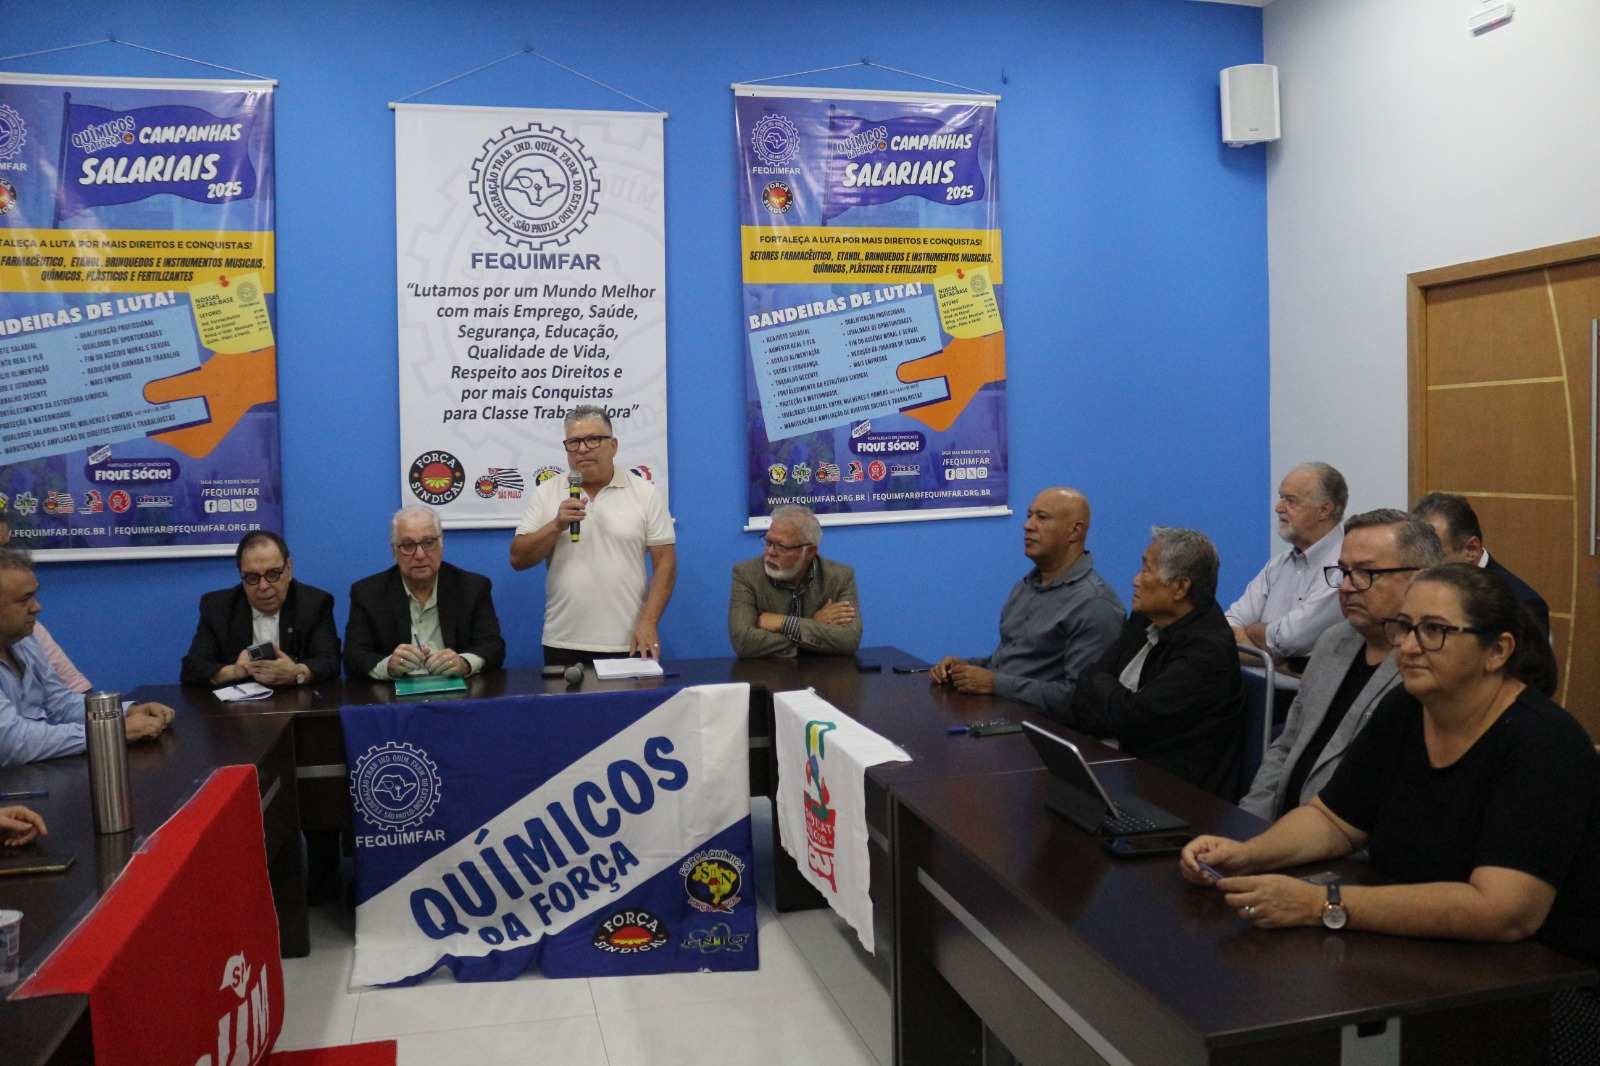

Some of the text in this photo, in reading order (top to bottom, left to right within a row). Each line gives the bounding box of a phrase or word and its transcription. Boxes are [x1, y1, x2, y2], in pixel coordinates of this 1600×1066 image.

[72, 115, 136, 148] QUÍMICOS
[138, 123, 243, 145] CAMPANHAS
[837, 125, 889, 153] QUÍMICOS
[84, 135, 121, 154] DA FORÇA
[513, 141, 533, 154] IND.
[890, 133, 973, 152] CAMPANHAS
[492, 148, 515, 171] TRAB.
[79, 153, 221, 185] SALARIAIS
[752, 166, 801, 175] FEQUIMFAR
[842, 160, 956, 188] SALARIAIS
[207, 181, 242, 199] 2025
[573, 179, 582, 192] DO
[766, 182, 789, 194] FORÇA
[946, 185, 974, 201] 2025
[487, 171, 513, 224] FEDERAÇÃO
[763, 199, 793, 214] SINDICAL
[558, 194, 582, 224] ESTADO
[40, 240, 47, 248] A
[50, 240, 76, 249] LUTA
[79, 240, 99, 249] POR
[102, 240, 127, 249] MAIS
[129, 240, 175, 249] DIREITOS
[178, 241, 184, 249] E
[186, 241, 253, 251] CONQUISTAS!
[759, 235, 810, 246] FORTALEÇA
[812, 236, 819, 244] A
[820, 236, 841, 244] LUTA
[842, 236, 860, 244] POR
[862, 236, 882, 245] MAIS
[884, 237, 922, 245] DIREITOS
[929, 238, 983, 246] CONQUISTAS!
[1, 253, 266, 270] FARMACÊUTICO, ETANOL, BRINQUEDOS E INSTRUMENTOS MUSICAIS,
[471, 252, 602, 270] FEQUIMFAR
[750, 251, 779, 261] SETORES
[780, 249, 834, 262] FARMACÊUTICO,
[837, 251, 864, 262] ETANOL,
[864, 252, 905, 262] BRINQUEDOS
[911, 252, 960, 262] INSTRUMENTOS
[961, 253, 993, 263] MUSICAIS,
[41, 268, 194, 282] QUÍMICOS, PLÁSTICOS E FERTILIZANTES
[813, 262, 848, 274] QUÍMICOS,
[849, 262, 884, 274] PLÁSTICOS
[891, 264, 937, 274] FERTILIZANTES
[195, 293, 220, 305] NOSSAS
[406, 282, 656, 300] “Lutamos por um Mundo Melhor
[85, 301, 114, 320] DE
[116, 289, 176, 314] LUTA!
[196, 296, 234, 310] DATAS-BASE
[436, 303, 639, 321] com mais Emprego, Saúde,
[749, 281, 923, 330] BANDEIRAS DE LUTA!
[79, 319, 155, 339] QUALIFICAÇÃO PROFISSIONAL
[457, 324, 619, 342] Segurança, Educação,
[467, 344, 611, 361] Qualidade de Vida,
[89, 372, 132, 386] MAIS EMPREGOS
[451, 364, 623, 382] Respeito aos Direitos e
[461, 384, 614, 402] por mais Conquistas
[443, 404, 640, 423] para Classe Trabora”
[4, 440, 41, 454] MANUTENÇÃO
[47, 433, 78, 446] AMPLIAÇÃO
[137, 414, 176, 427] TRABALHISTAS
[857, 439, 920, 453] FIQUE SÓCIO!
[415, 452, 457, 470] FORÇA
[942, 457, 990, 467] /FEQUIMFAR
[95, 467, 172, 481] FIQUE SÓCIO!
[477, 475, 495, 484] FORÇA
[201, 487, 260, 498] /FEQUIMFAR
[411, 481, 464, 504] SINDICAL
[475, 487, 498, 498] SINDICAL
[498, 490, 522, 499] SÃO PAULO
[767, 489, 991, 505] WWW.FEQUIMFAR.ORG.BR FEQUIMFAR@FEQUIMFAR.ORG.BR
[9, 523, 261, 539] .FEQUIMFAR.ORG.BR FEQUIMFAR@FEQUIMFAR.ORG.BR
[355, 829, 446, 848] FEQUIMFAR
[410, 736, 689, 941] QUÍMICOS
[680, 851, 707, 876] FORÇA
[708, 849, 746, 874] QUÍMICA
[478, 841, 641, 946] DA FORÇA
[603, 911, 659, 933] FORÇA
[594, 938, 667, 954] SINDICAL
